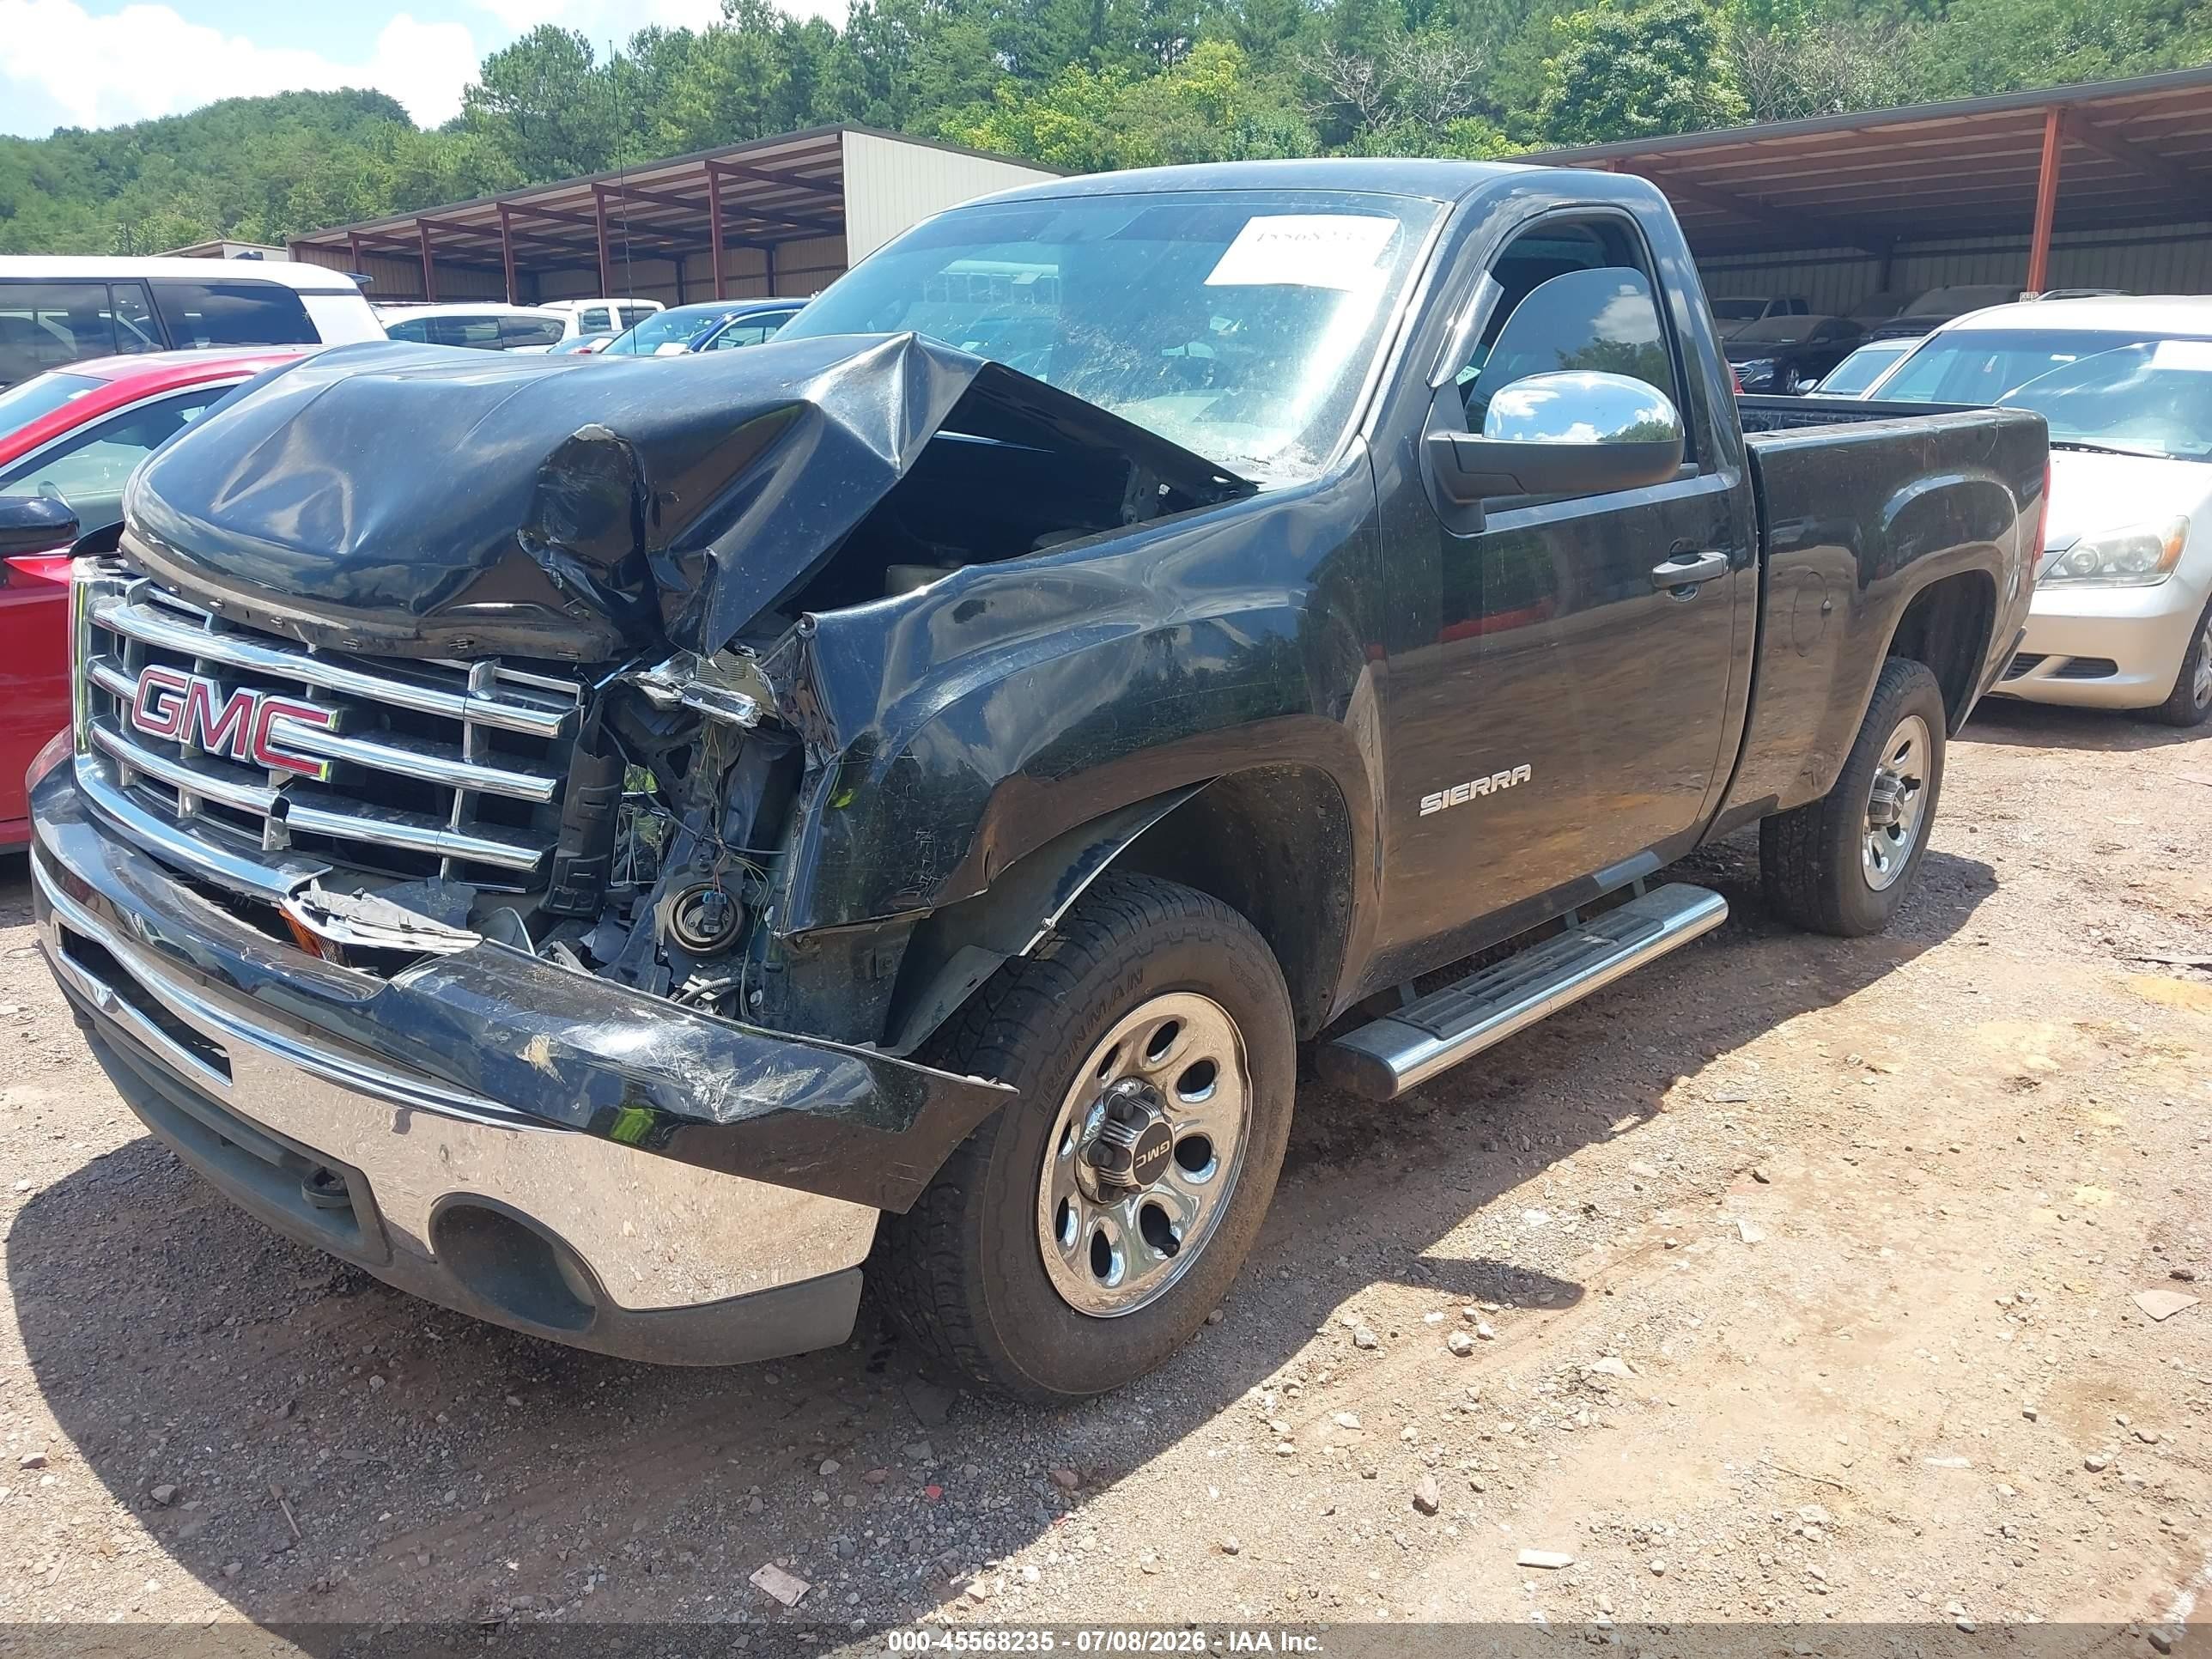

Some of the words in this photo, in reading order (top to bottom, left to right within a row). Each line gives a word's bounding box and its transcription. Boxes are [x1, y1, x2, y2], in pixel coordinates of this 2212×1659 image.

[131, 664, 340, 783] GMC
[1419, 763, 1532, 817] SIERRA
[1035, 968, 1145, 1115] IRONMAN
[1135, 1139, 1170, 1169] GMC
